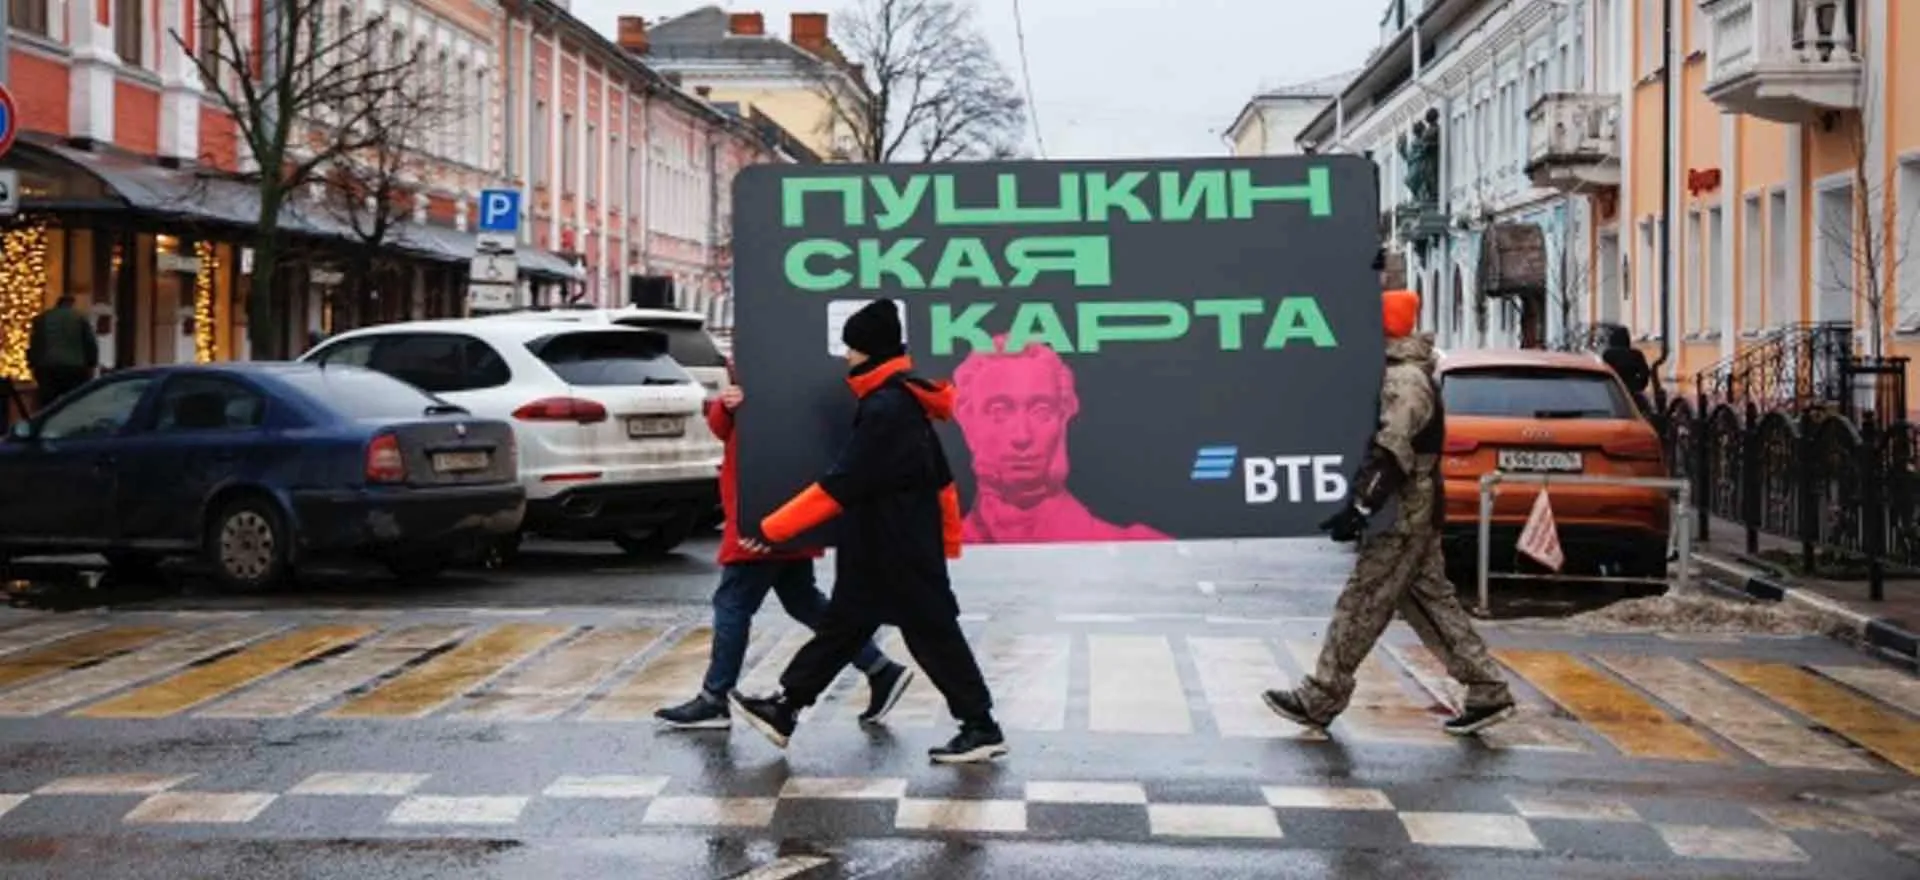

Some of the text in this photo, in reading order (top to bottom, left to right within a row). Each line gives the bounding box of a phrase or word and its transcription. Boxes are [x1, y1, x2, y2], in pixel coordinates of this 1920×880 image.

[486, 194, 511, 225] P
[781, 165, 1333, 230] ПУШКИН
[783, 234, 1112, 291] СКАЯ
[930, 296, 1337, 356] КАРТА
[1244, 455, 1347, 503] ВТБ
